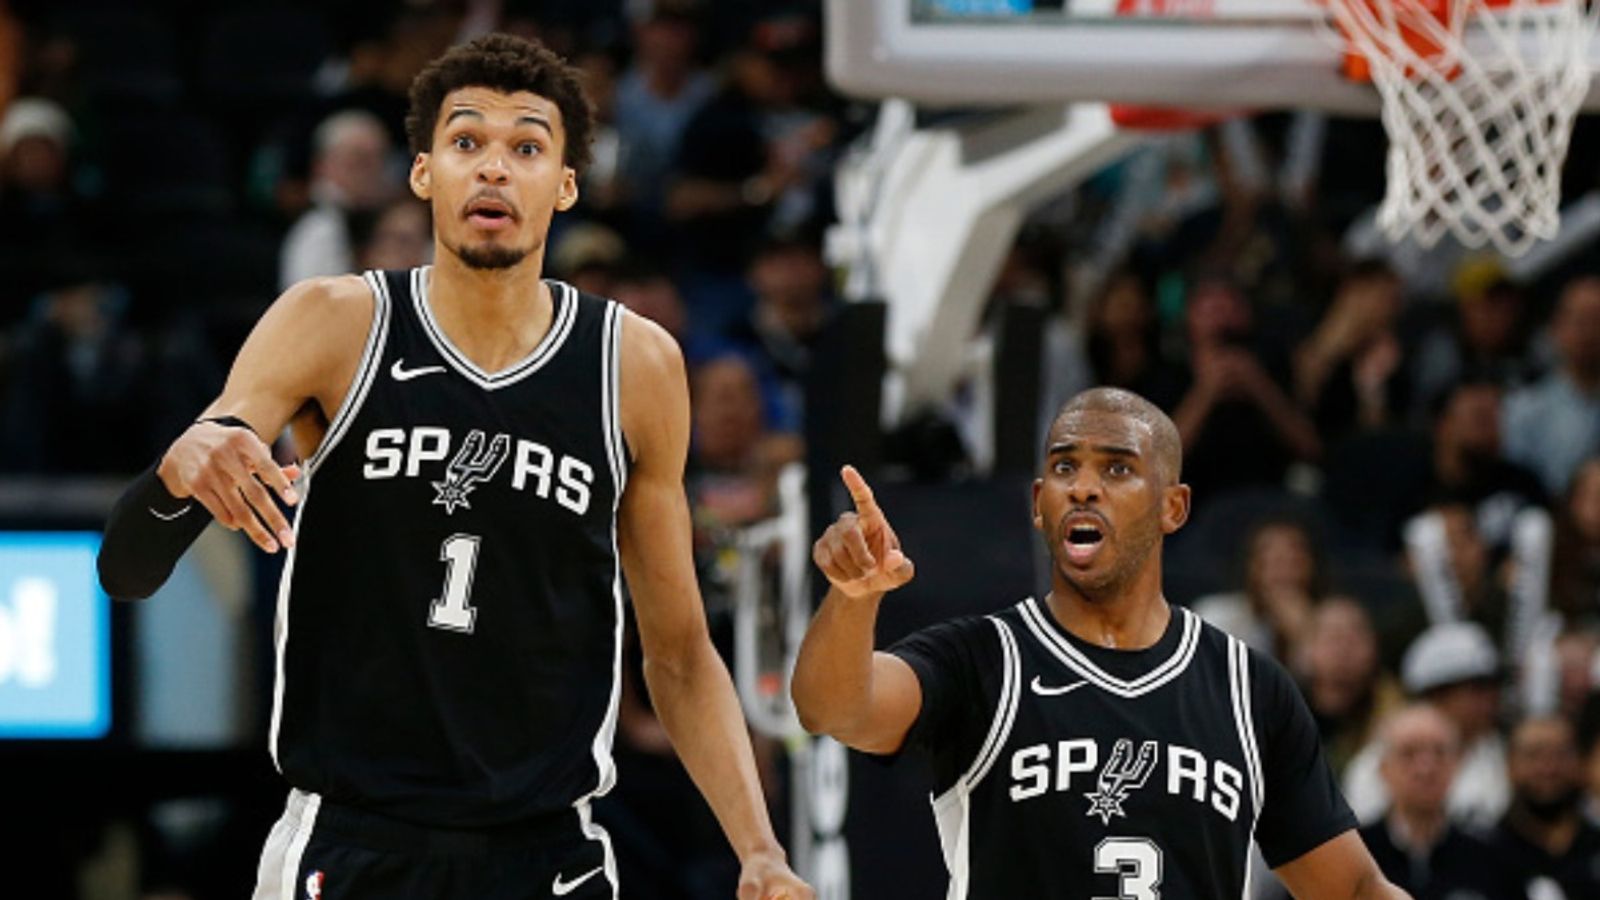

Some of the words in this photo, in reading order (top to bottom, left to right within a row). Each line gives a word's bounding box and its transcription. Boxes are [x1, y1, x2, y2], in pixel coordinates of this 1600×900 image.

[363, 427, 594, 515] SPURS
[427, 533, 482, 634] 1
[1009, 738, 1243, 826] SPURS
[1091, 836, 1163, 900] 3
